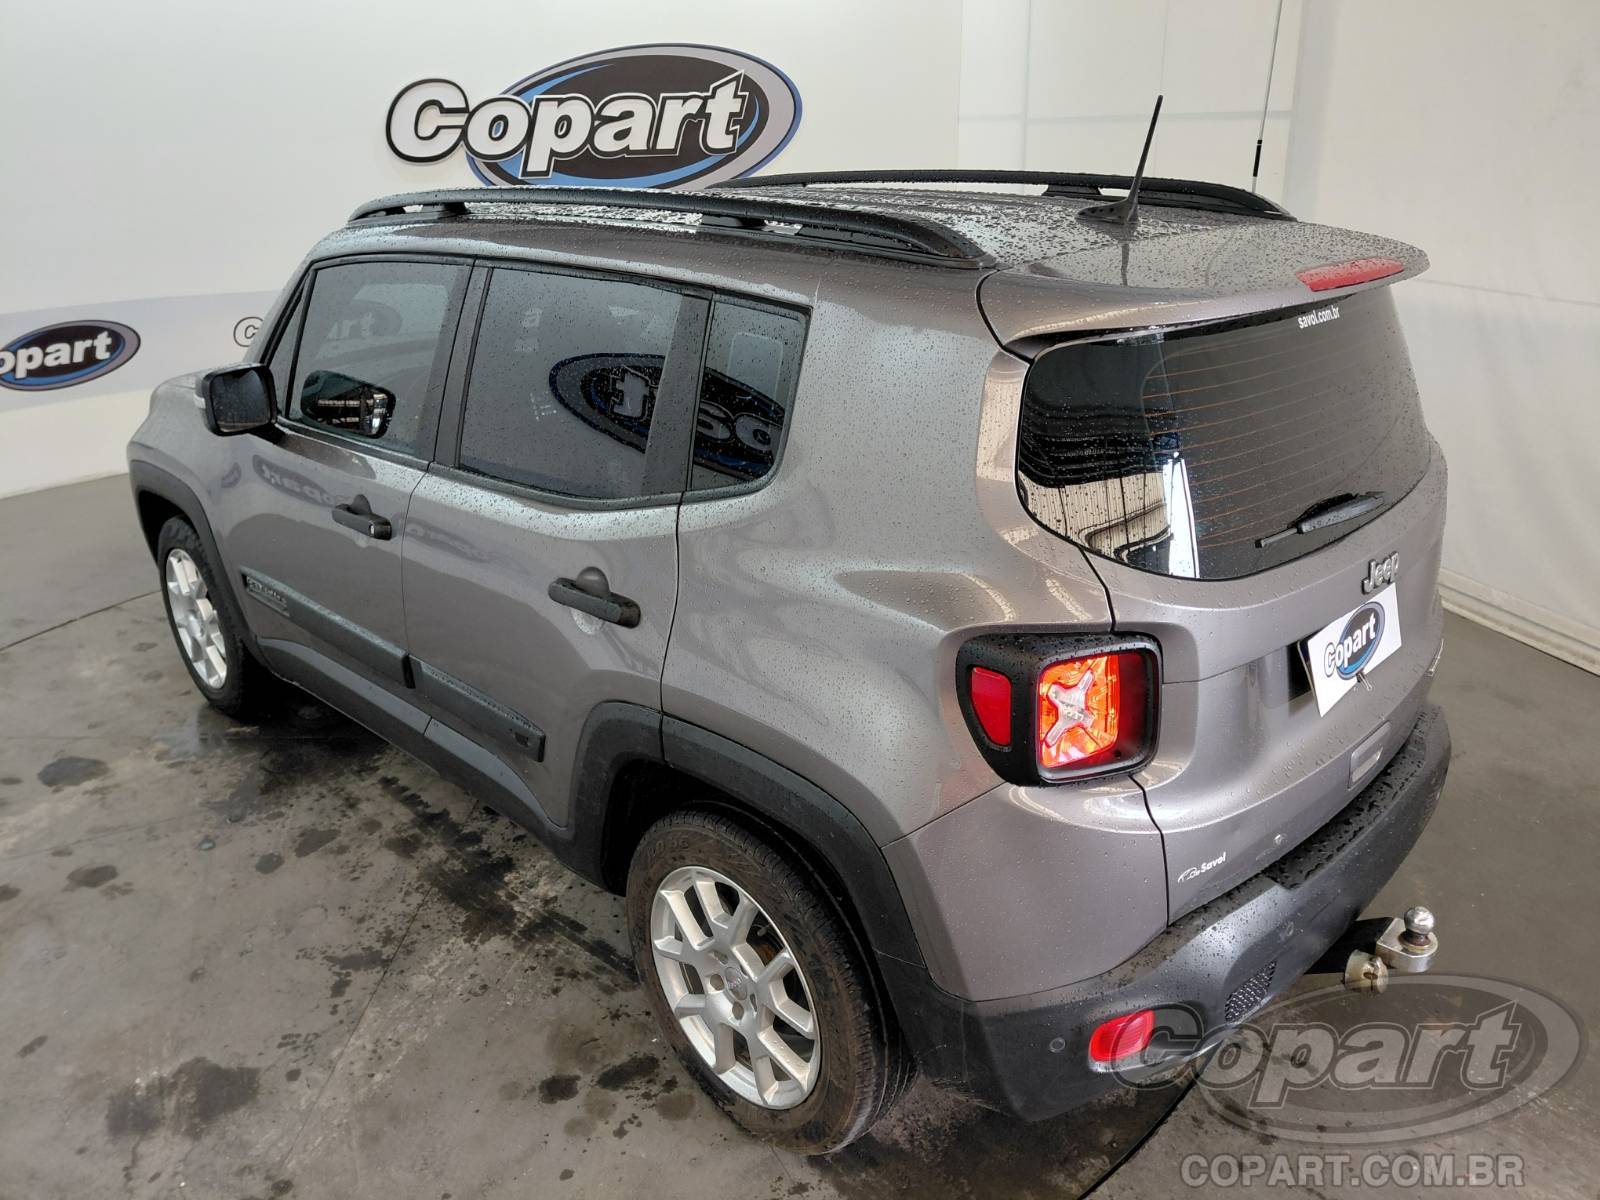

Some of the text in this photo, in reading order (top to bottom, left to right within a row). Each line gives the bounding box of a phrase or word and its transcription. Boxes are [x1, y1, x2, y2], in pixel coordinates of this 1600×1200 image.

[386, 70, 749, 178] Copart
[1297, 304, 1340, 329] savol.com.br
[1361, 551, 1399, 594] Jeep
[1324, 612, 1377, 678] Copart
